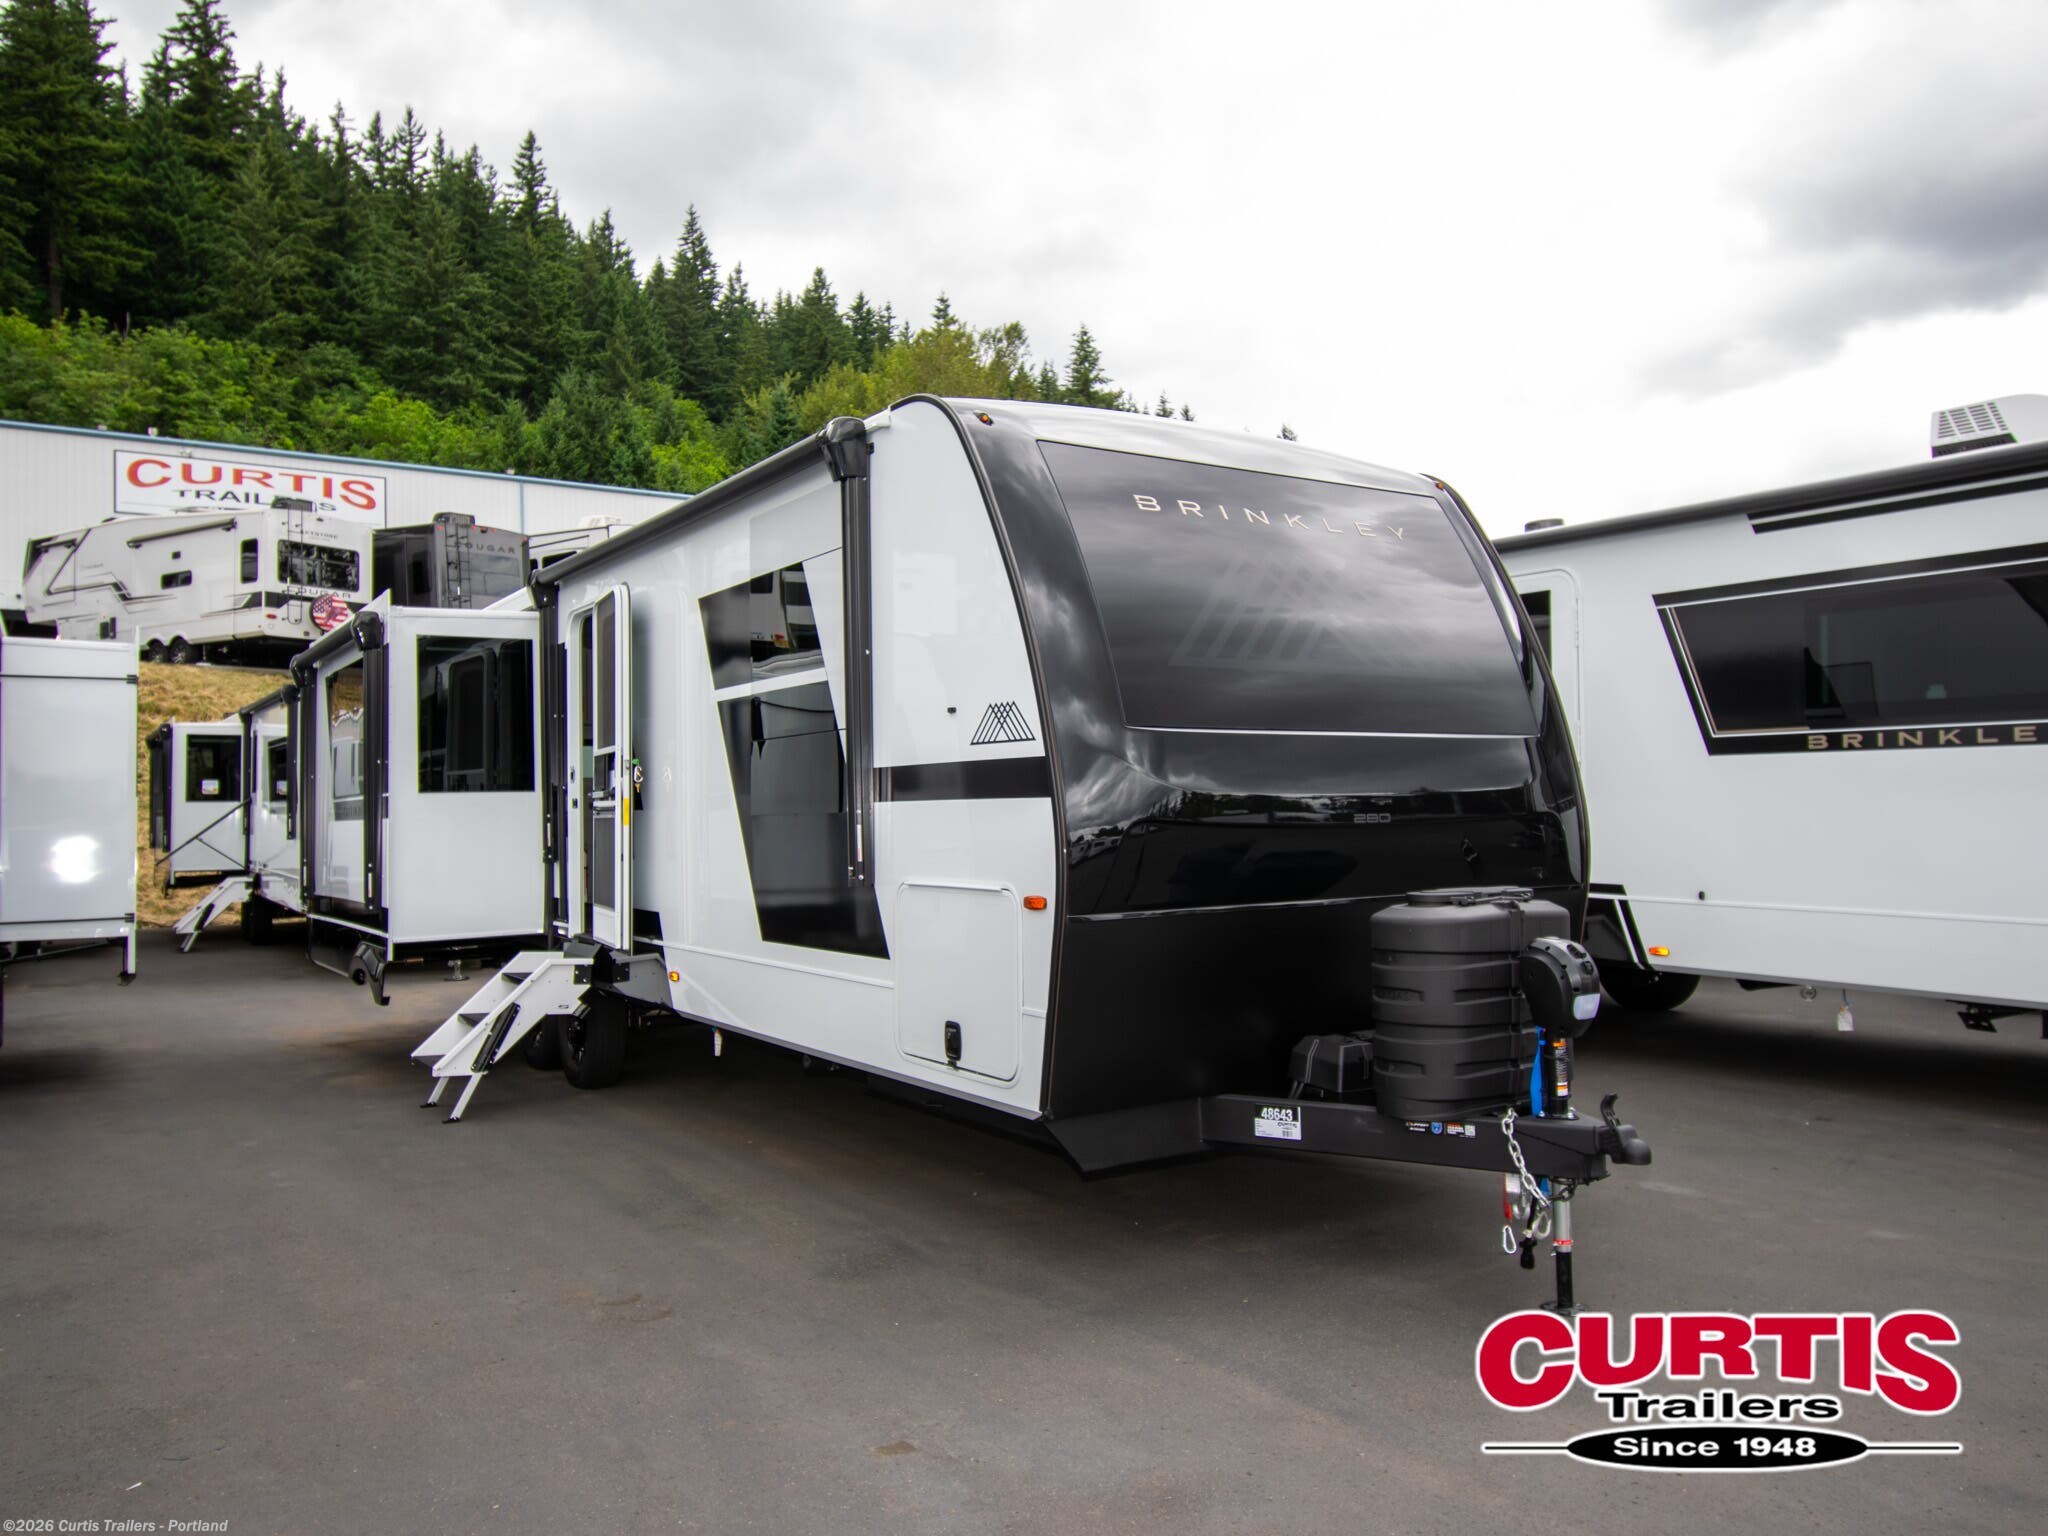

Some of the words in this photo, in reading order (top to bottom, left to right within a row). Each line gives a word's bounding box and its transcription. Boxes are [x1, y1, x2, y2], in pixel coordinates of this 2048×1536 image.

[126, 459, 376, 510] CURTIS
[172, 489, 336, 512] TRAILS
[1133, 494, 1404, 540] BRINKLEY
[1807, 726, 2038, 750] BRINKLE
[1261, 1107, 1293, 1121] 48643
